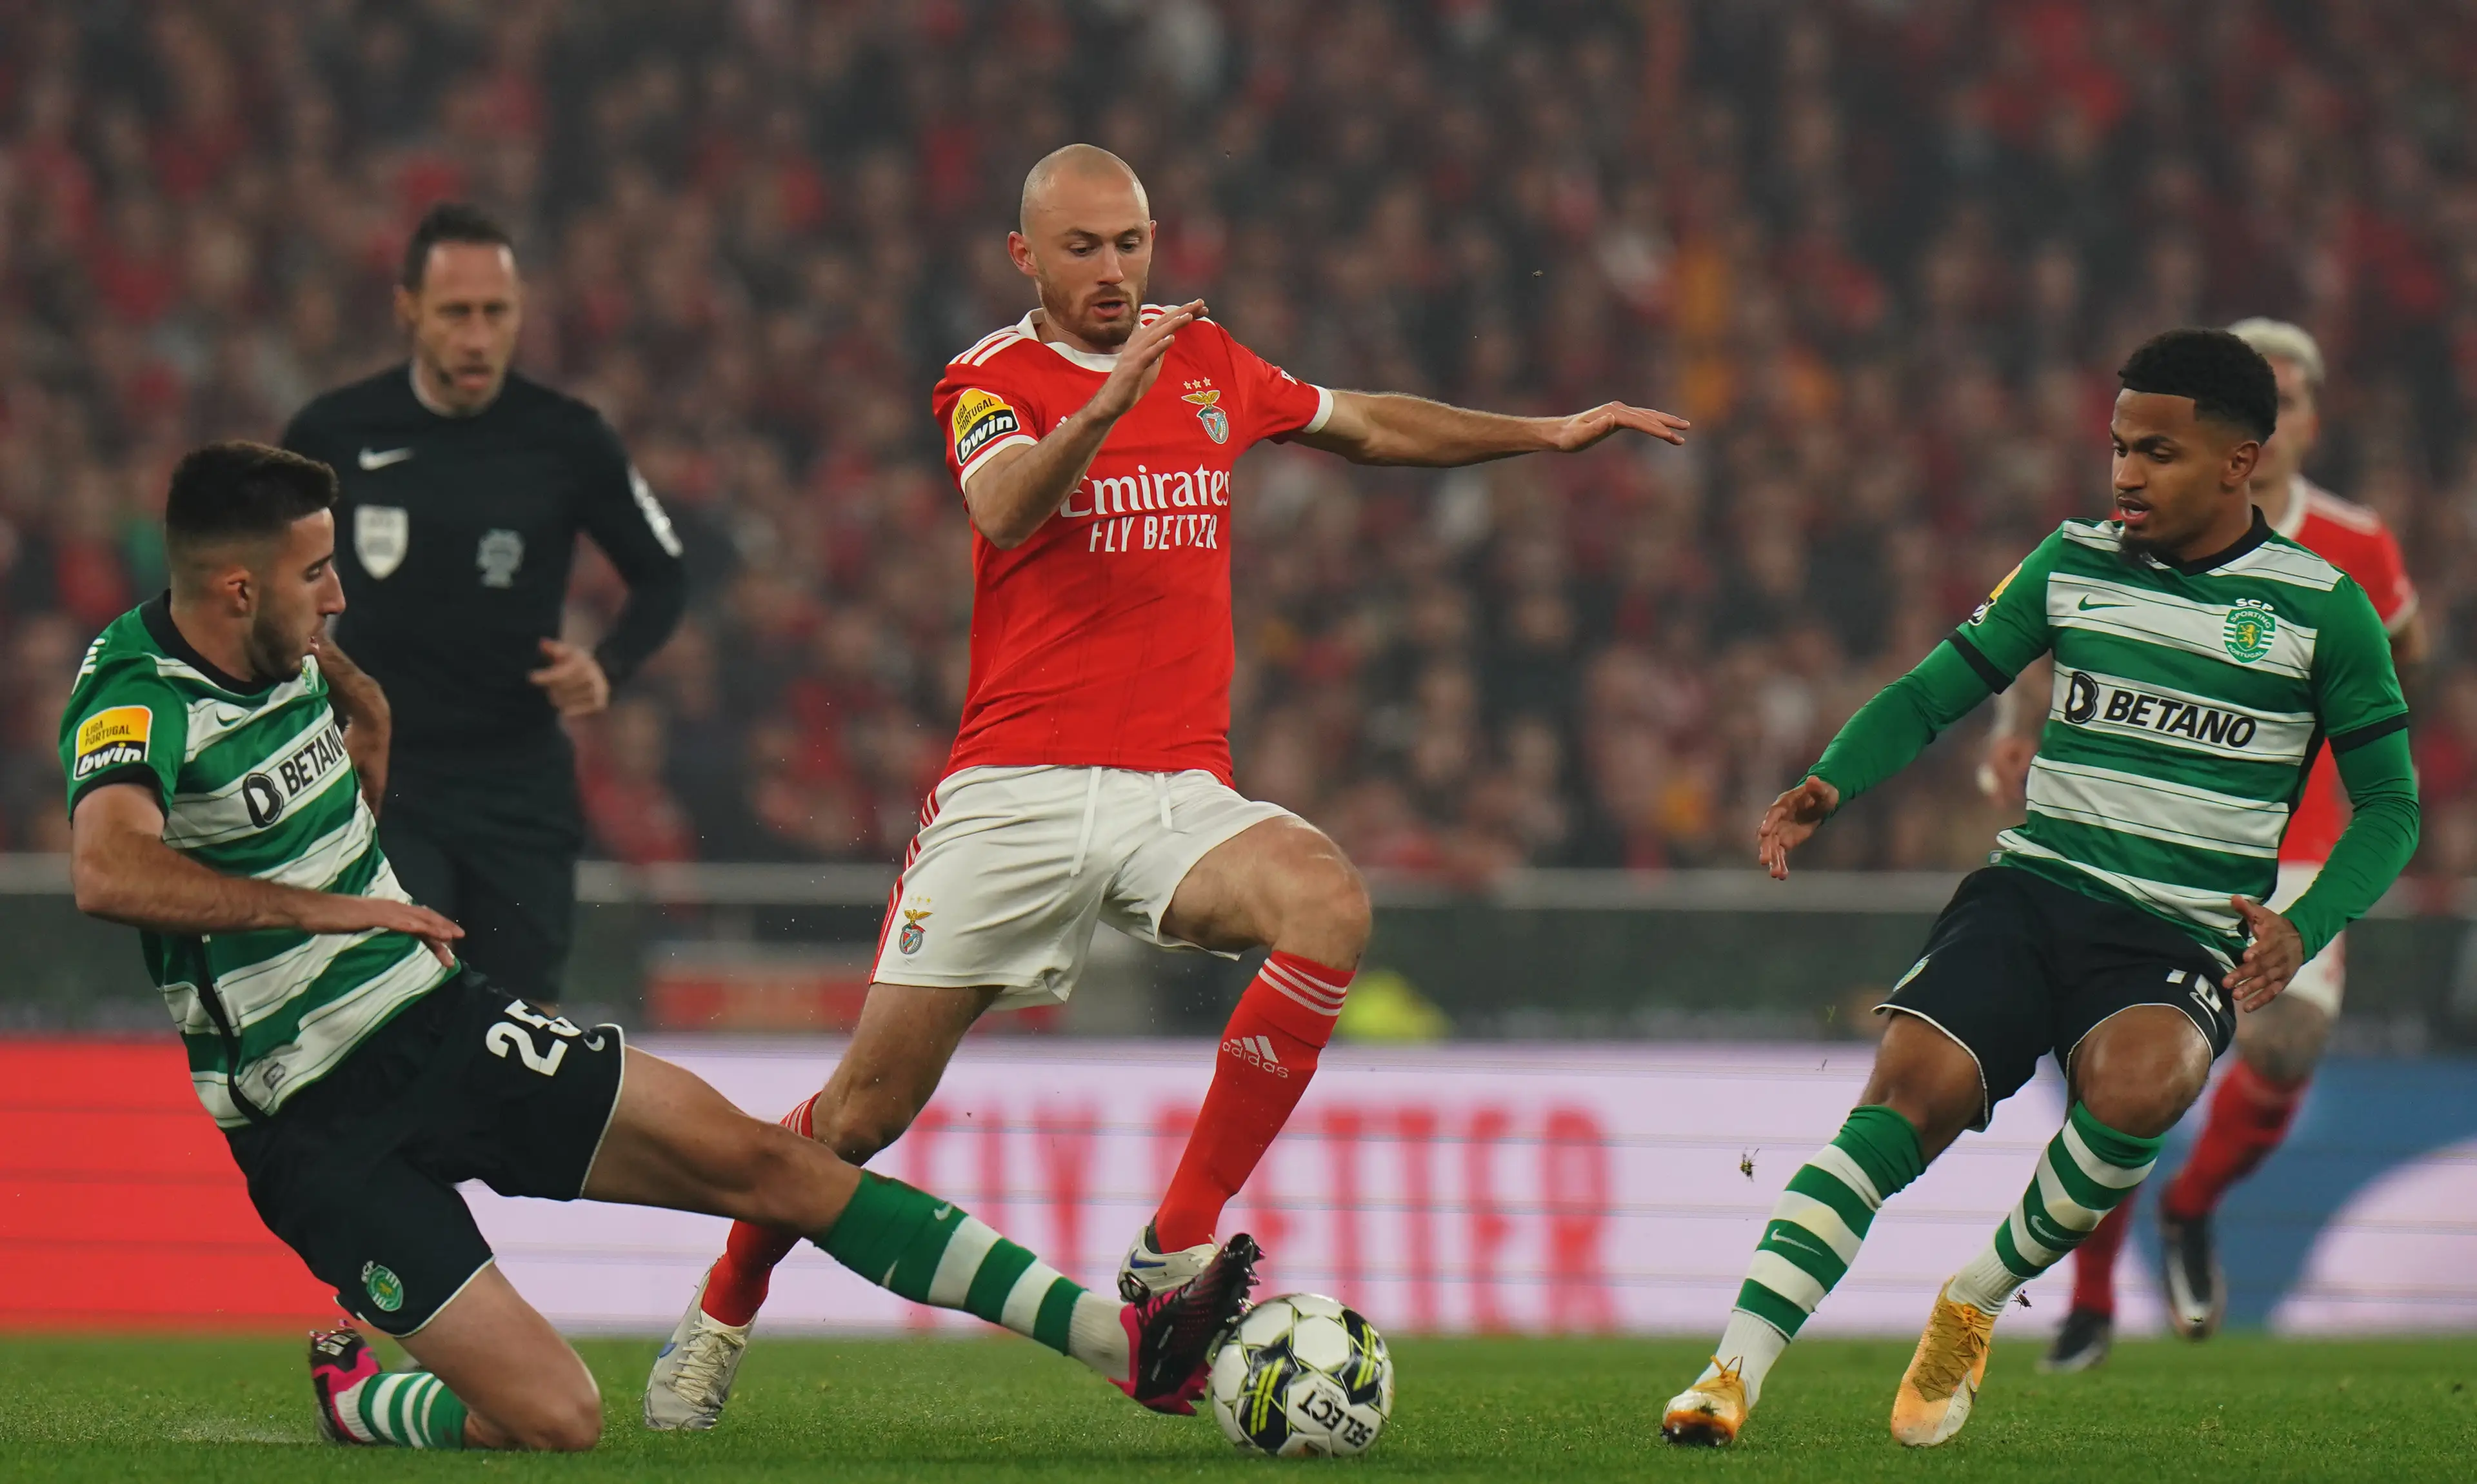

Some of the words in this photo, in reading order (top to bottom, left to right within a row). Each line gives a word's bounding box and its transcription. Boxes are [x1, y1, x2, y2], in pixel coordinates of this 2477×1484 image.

[956, 403, 967, 425] LIGA
[959, 397, 995, 435] PORTUGAL
[960, 415, 1013, 460] bwin
[1060, 463, 1230, 518] Emirates
[1089, 516, 1135, 553] FLY
[1143, 514, 1218, 550] BETTER
[2230, 611, 2272, 629] SPORTING
[2235, 598, 2274, 611] SCP
[2227, 644, 2264, 658] PORTUGAL
[85, 724, 131, 747] PORTUGAL
[86, 720, 103, 737] LIGA
[2103, 689, 2256, 748] BETANO
[77, 742, 142, 776] bwin
[278, 724, 346, 798] BETAN
[1222, 1042, 1289, 1078] adidas
[1297, 1390, 1373, 1448] SELECT
